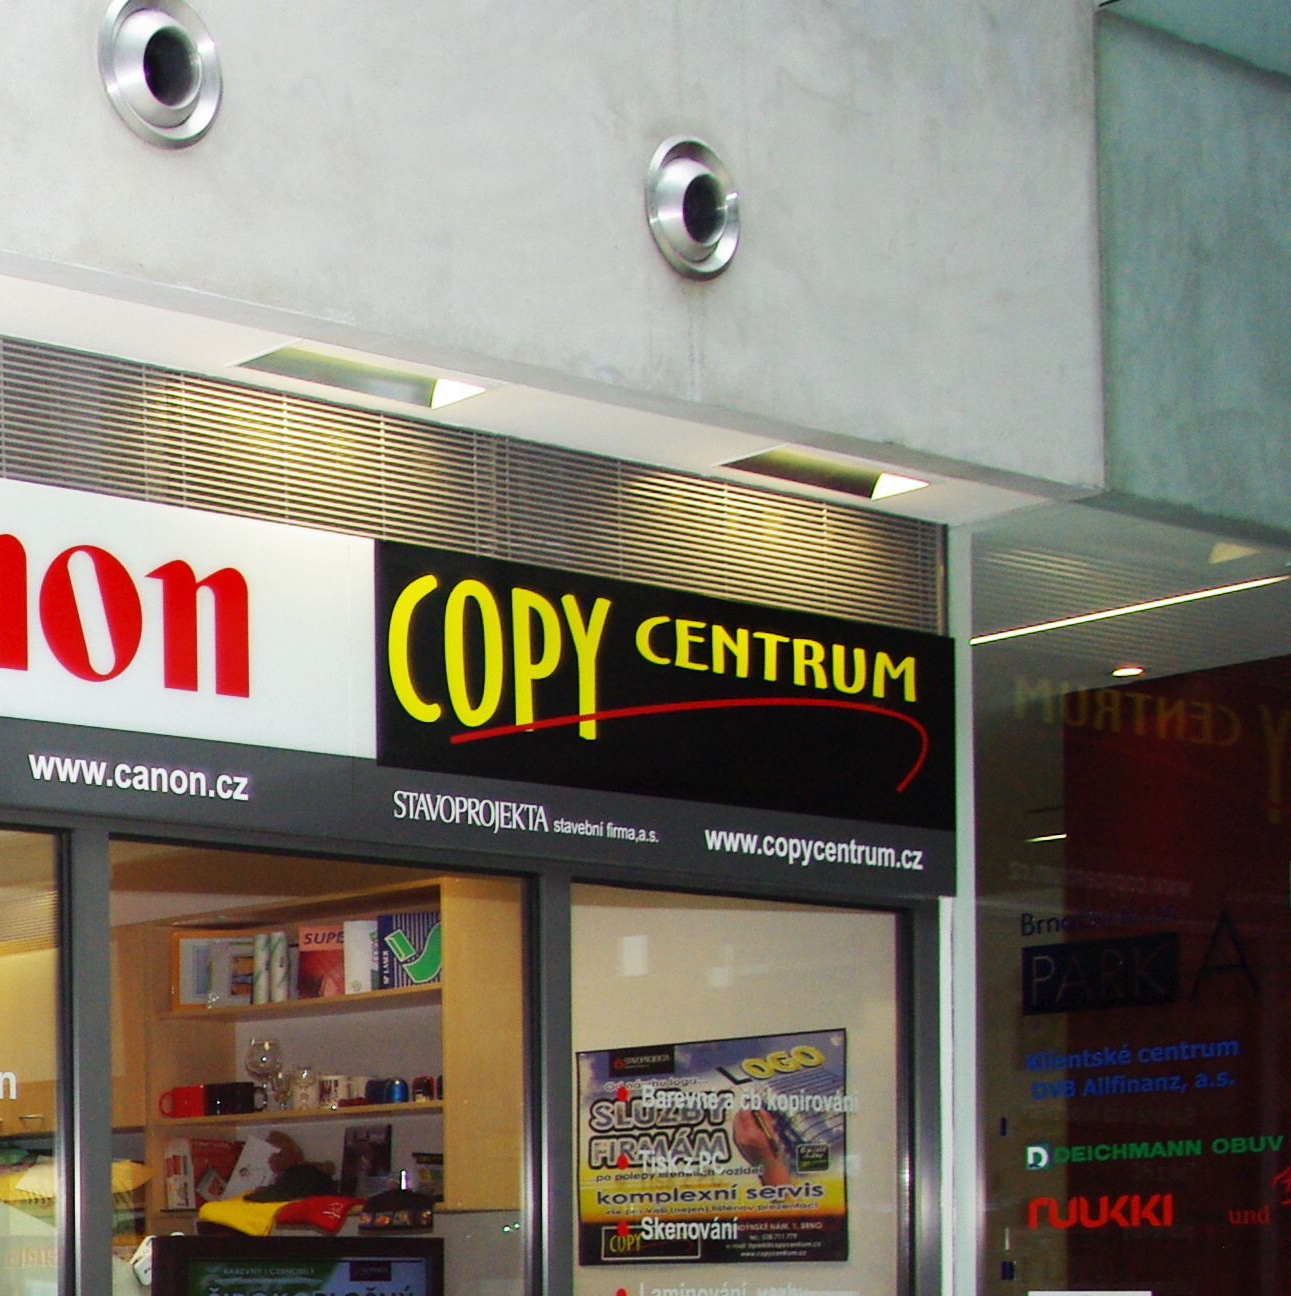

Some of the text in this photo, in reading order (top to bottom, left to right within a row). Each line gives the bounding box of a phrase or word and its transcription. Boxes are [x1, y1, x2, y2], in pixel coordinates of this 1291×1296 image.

[388, 574, 917, 740] COPY CENTRUM
[28, 752, 250, 802] www.canon.cz
[393, 790, 549, 834] STAVOPROJEKTA
[553, 816, 604, 839] stavební
[705, 829, 924, 872] www.copycentrum.cz
[1031, 944, 1167, 1006] PARK
[716, 1045, 825, 1085] LOGO
[1025, 1038, 1240, 1072] Klientské centrum
[641, 1084, 719, 1110] Barevné
[724, 1094, 735, 1110] a
[767, 1089, 859, 1114] kopírování
[1082, 1071, 1188, 1097] Allfinanz,
[1195, 1069, 1238, 1088] a.s.
[639, 1149, 678, 1174] Tisk
[699, 1151, 726, 1175] PC
[1054, 1135, 1284, 1163] DEICHMANN OBUV
[597, 1182, 824, 1205] komplexní servis
[1028, 1193, 1271, 1228] ruukki und
[609, 1235, 641, 1253] COPY
[640, 1216, 739, 1241] Skenování
